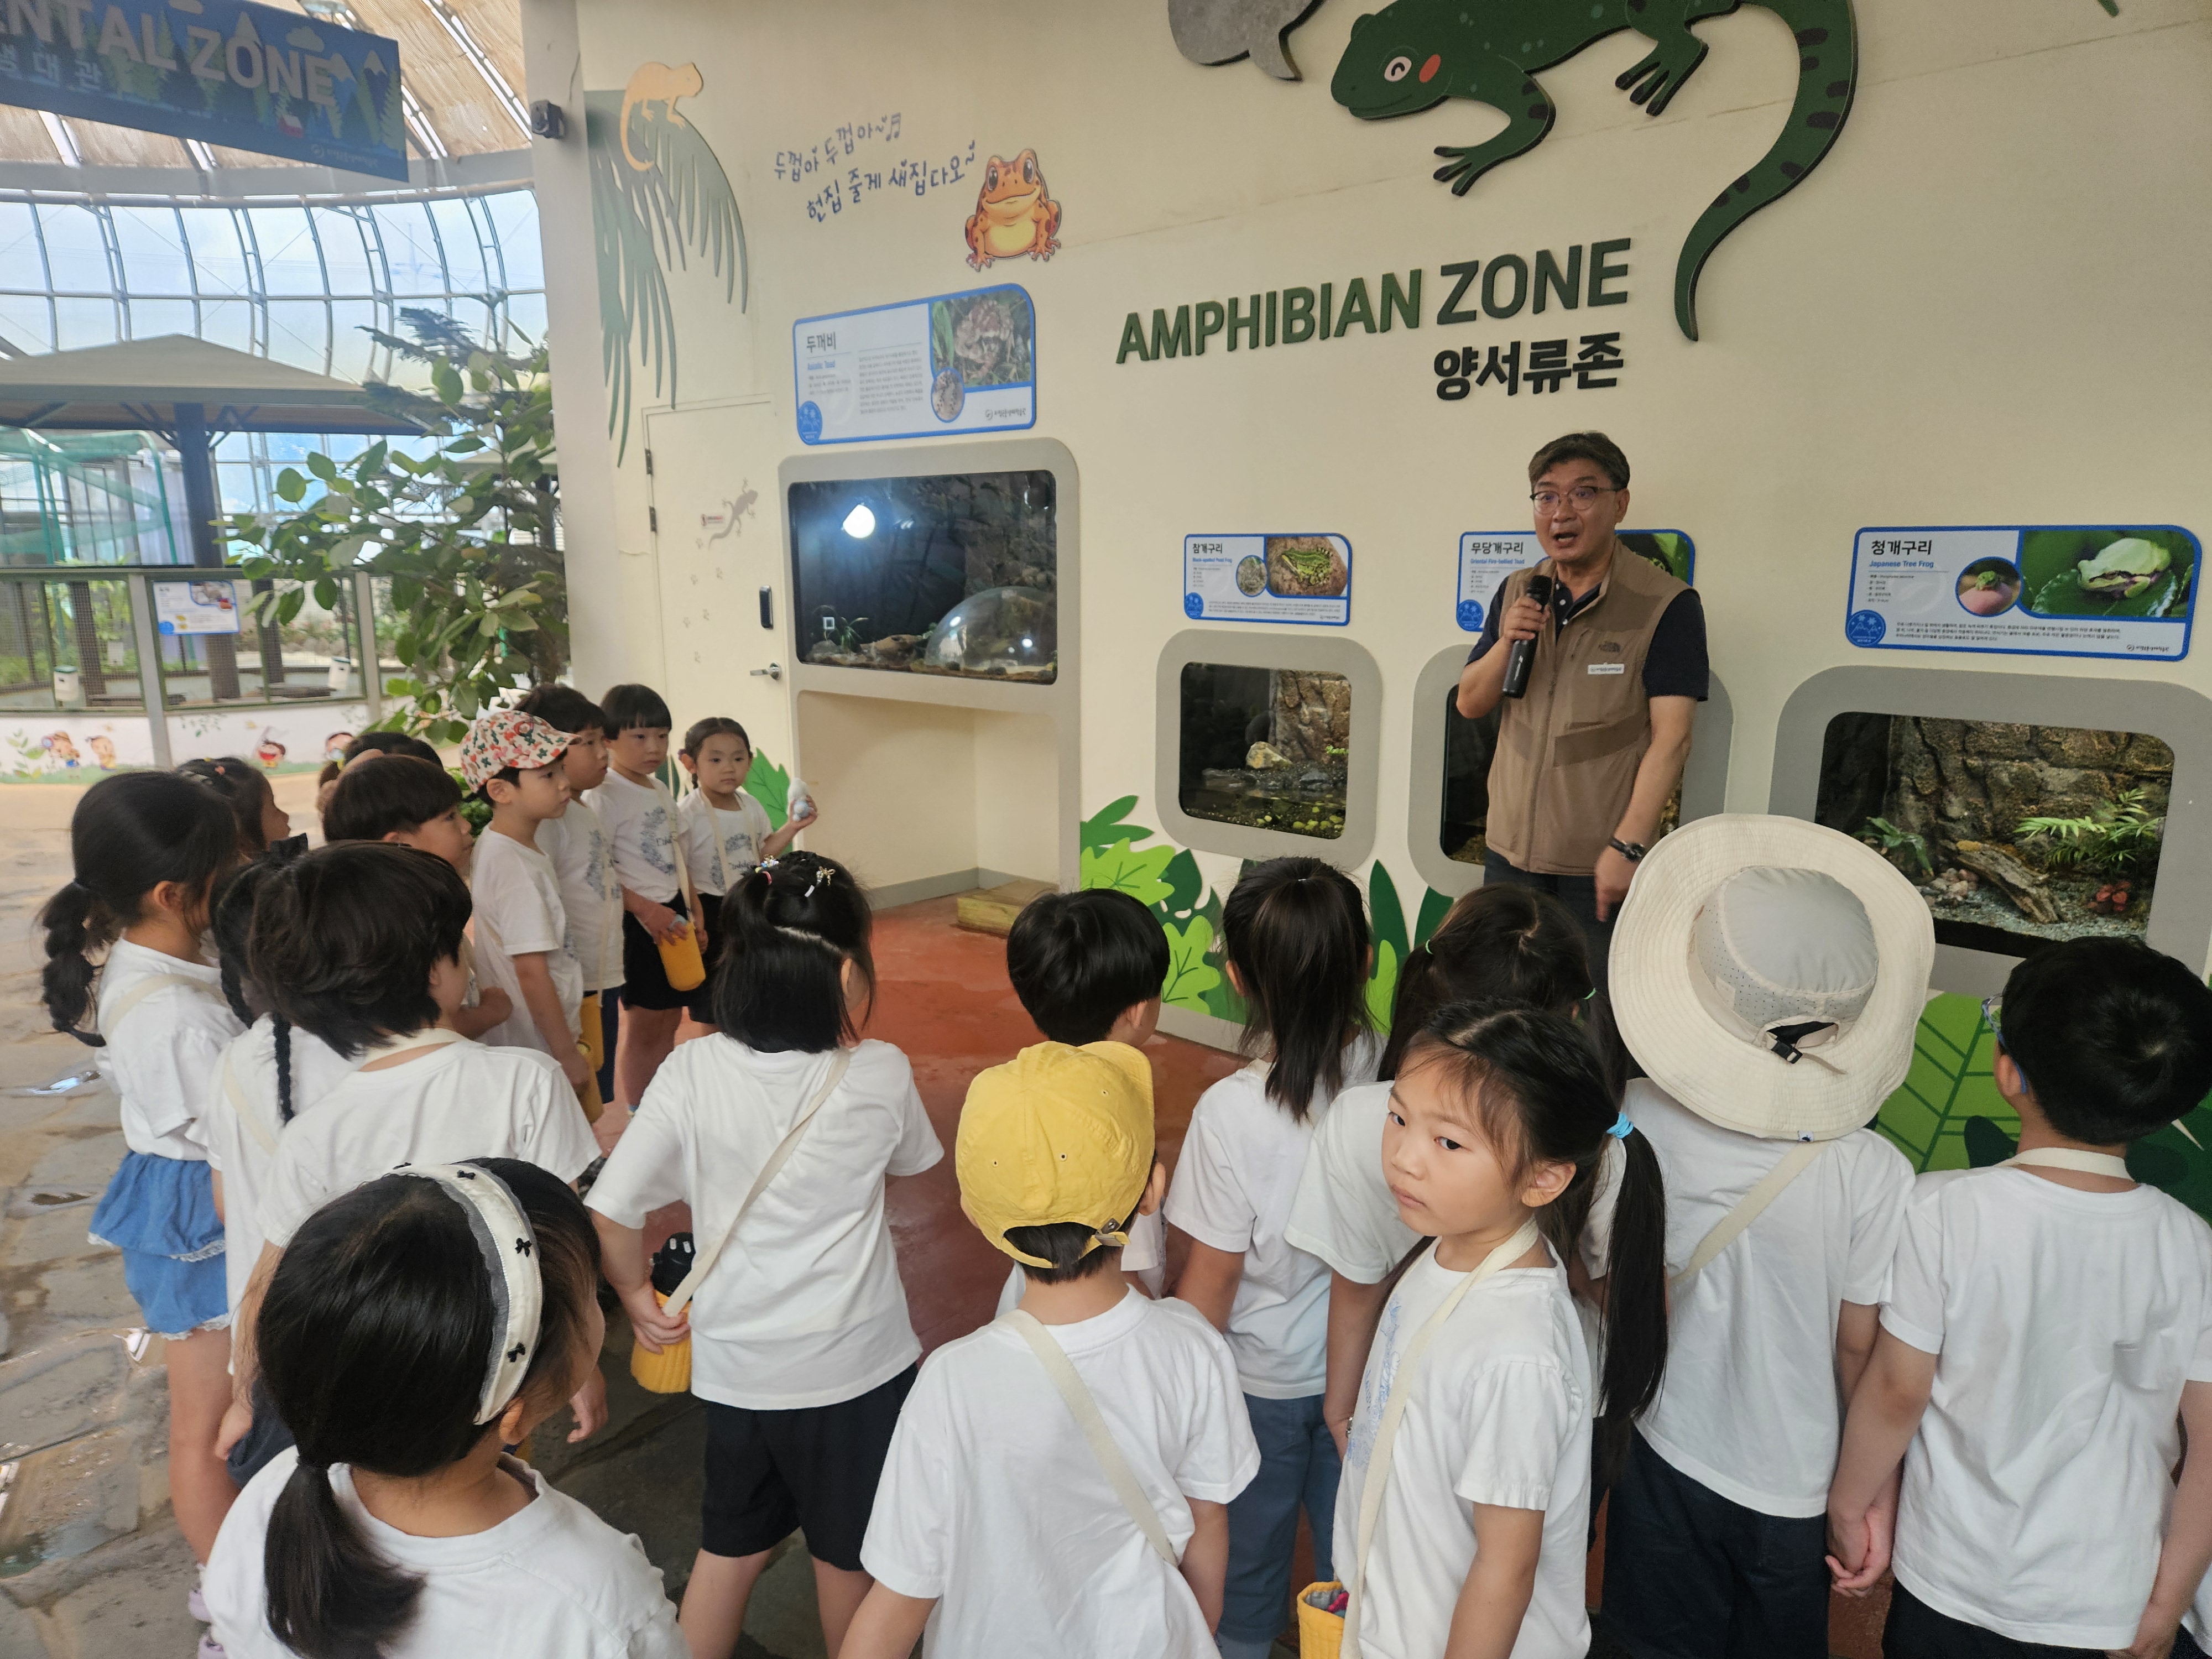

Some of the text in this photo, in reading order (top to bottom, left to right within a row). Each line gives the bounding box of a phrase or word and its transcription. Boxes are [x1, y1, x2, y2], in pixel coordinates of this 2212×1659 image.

[0, 0, 335, 106] NTAL ZONE
[807, 179, 842, 222] 헌집
[848, 167, 881, 204] 줄게
[1115, 237, 1631, 364] AMPHIBIAN ZONE
[806, 331, 836, 353] 두꺼비
[1433, 332, 1624, 401] 양서류존
[1193, 542, 1223, 554] 참개구리
[1471, 541, 1524, 555] 무당개구리
[1871, 540, 1932, 555] 청개구리
[1918, 560, 1934, 568] Frog
